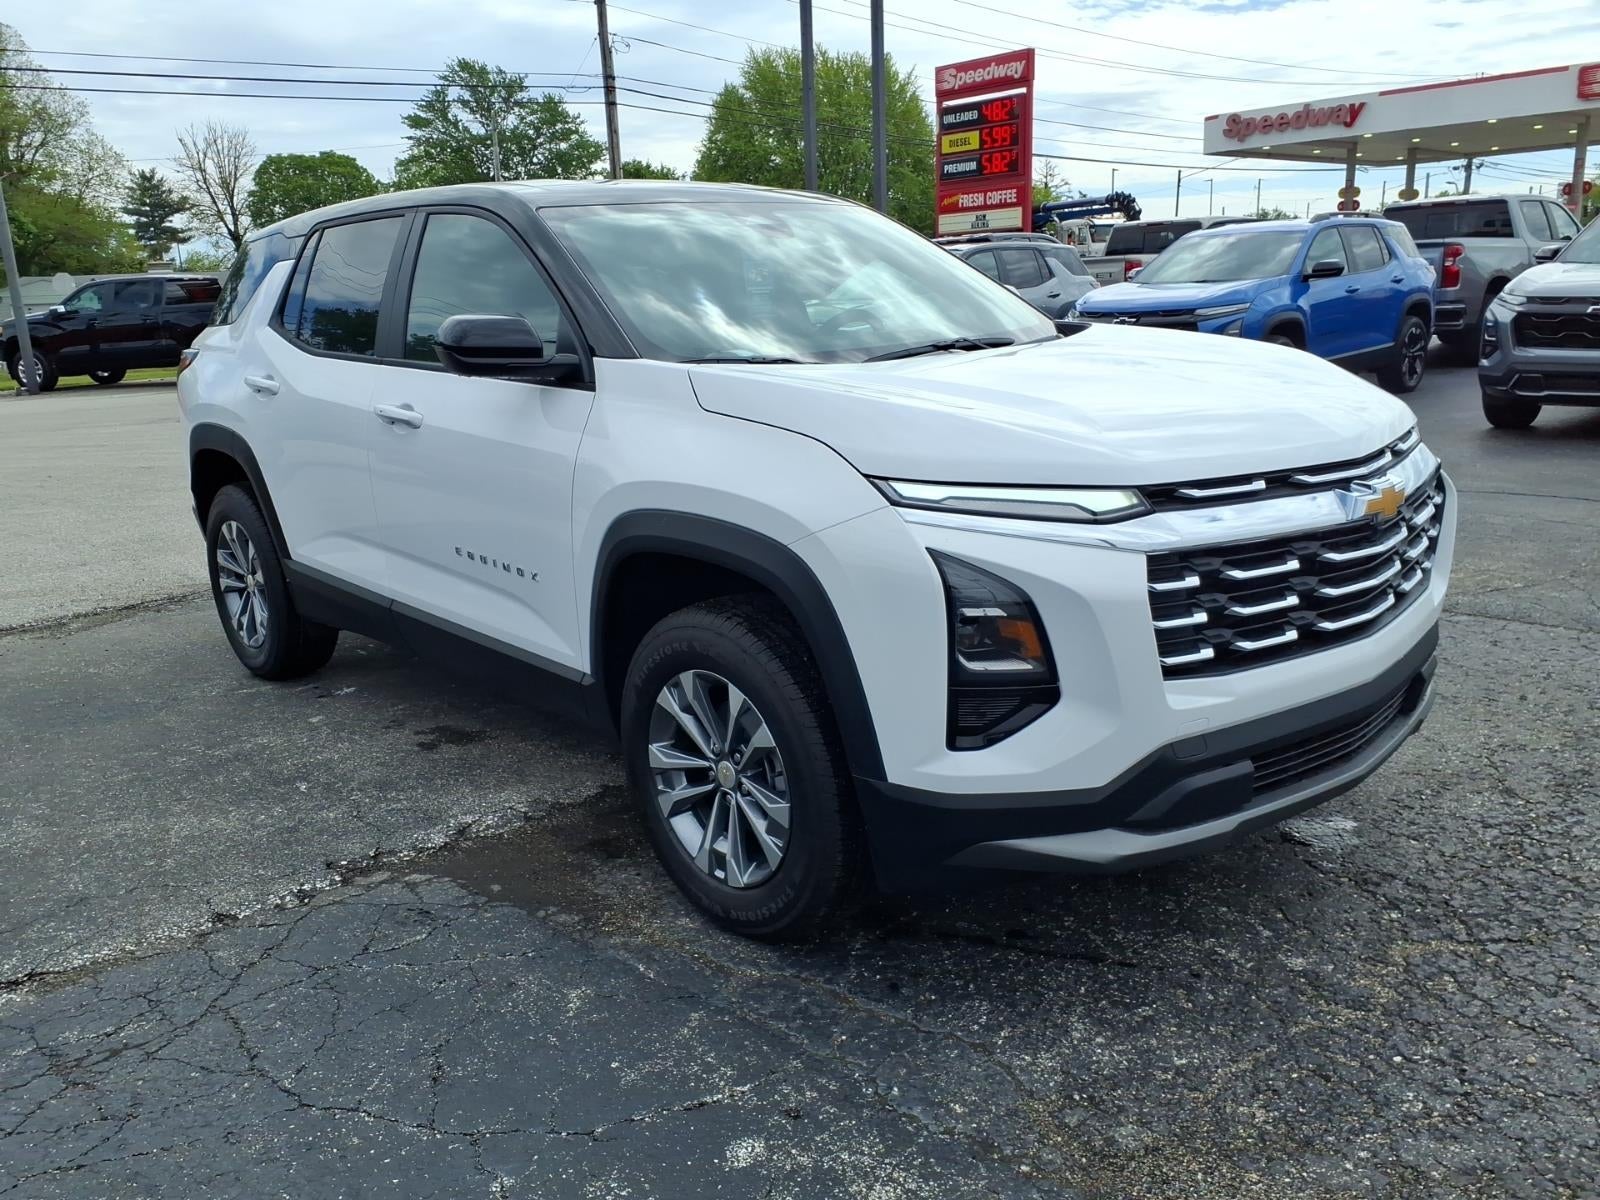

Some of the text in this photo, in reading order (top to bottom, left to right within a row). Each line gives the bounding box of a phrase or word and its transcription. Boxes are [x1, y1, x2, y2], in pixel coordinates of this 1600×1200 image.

[941, 60, 1026, 90] Speedway
[943, 110, 978, 124] UNLEADED
[1222, 102, 1368, 143] Speedway
[948, 137, 972, 148] DIESEL
[944, 161, 977, 173] PREMIUM
[959, 192, 985, 208] FRESH
[986, 189, 1017, 205] COFFEE
[454, 546, 540, 582] EQUINOX
